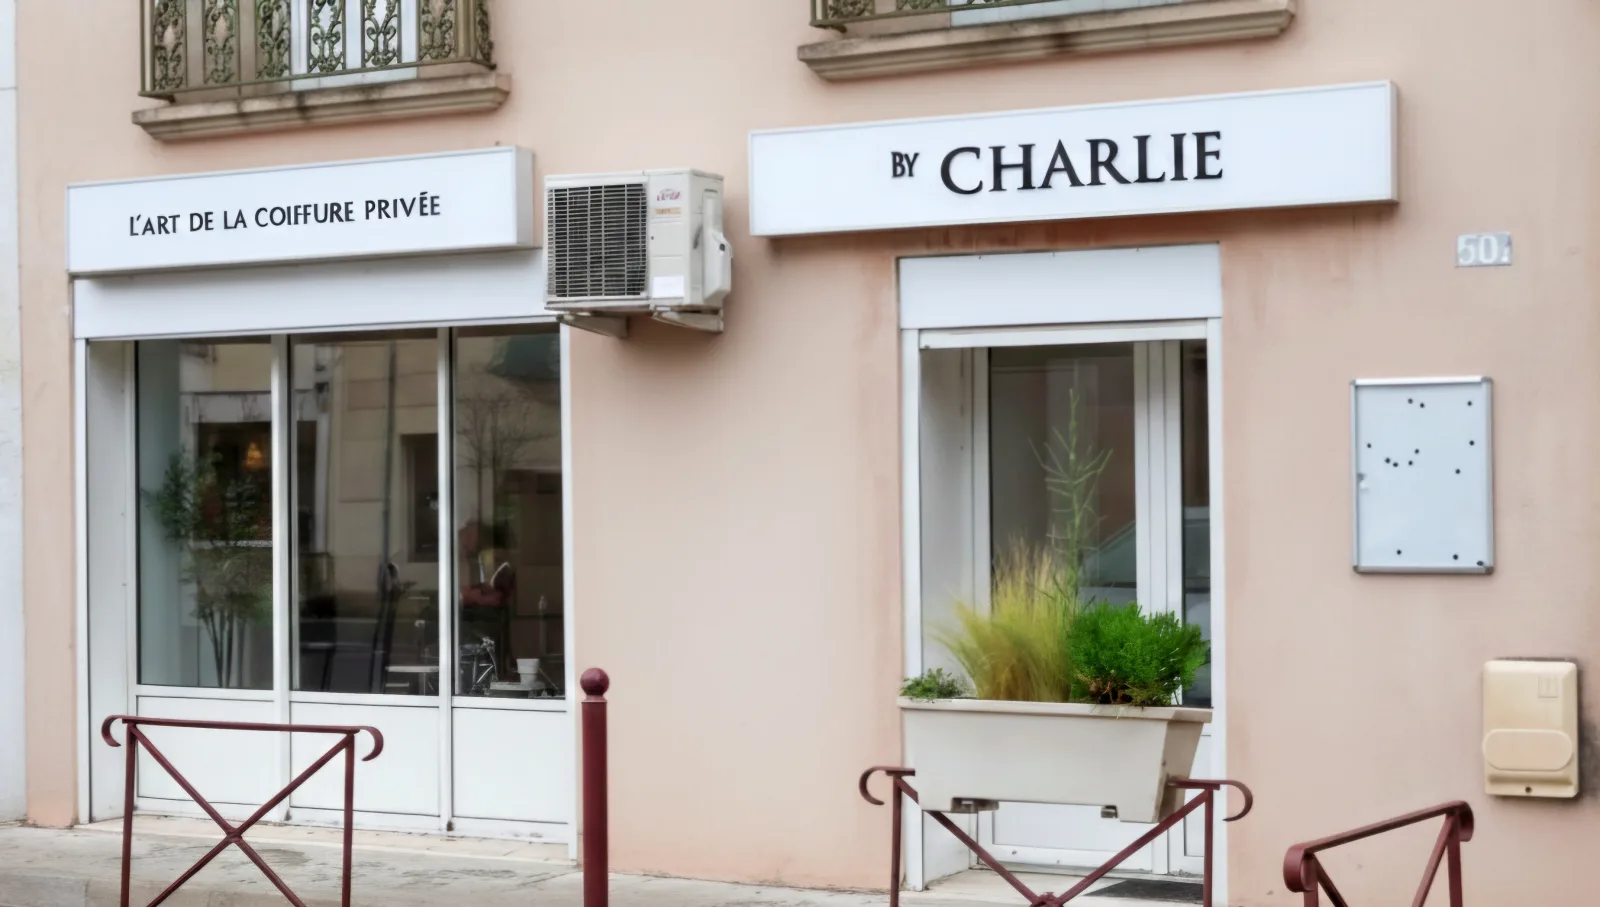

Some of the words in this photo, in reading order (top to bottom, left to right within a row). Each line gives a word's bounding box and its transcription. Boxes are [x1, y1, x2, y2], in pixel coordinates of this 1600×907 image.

[890, 151, 920, 180] BY
[940, 130, 1223, 196] CHARLIE
[129, 214, 181, 237] L'ART
[190, 211, 214, 232] DE
[223, 209, 248, 230] LA
[254, 202, 357, 228] COIFFURE
[364, 191, 441, 221] PRIVÉE
